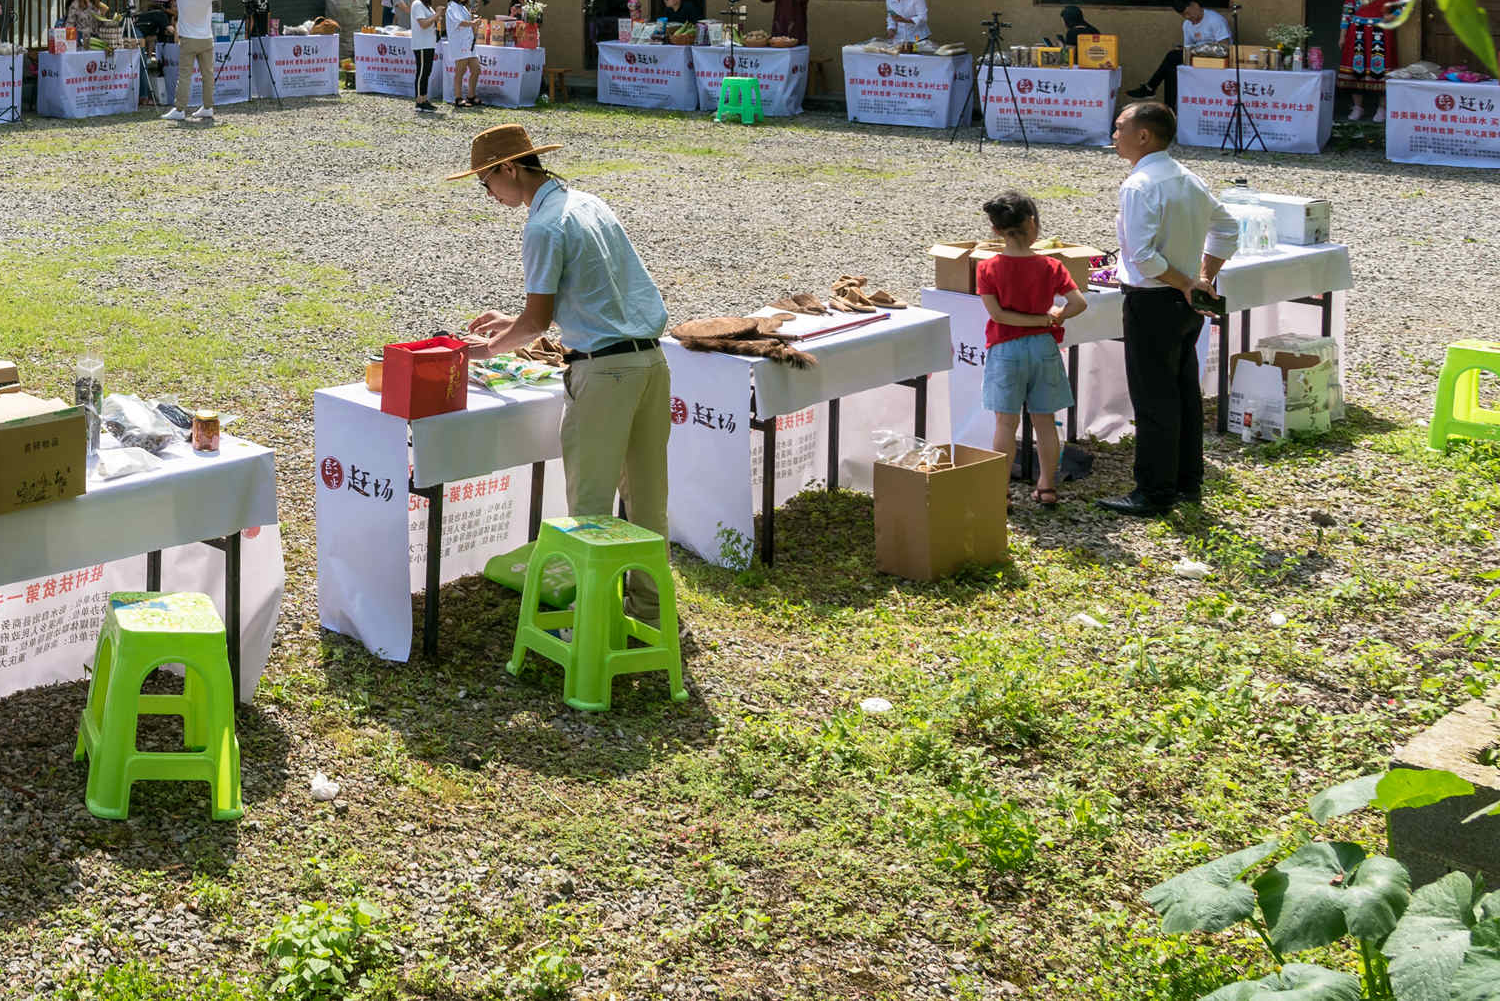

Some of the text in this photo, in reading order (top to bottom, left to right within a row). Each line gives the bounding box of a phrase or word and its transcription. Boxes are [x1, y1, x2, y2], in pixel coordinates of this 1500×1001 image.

[1458, 95, 1495, 112] 赶场
[692, 402, 736, 434] 赶场
[347, 464, 394, 502] 赶场
